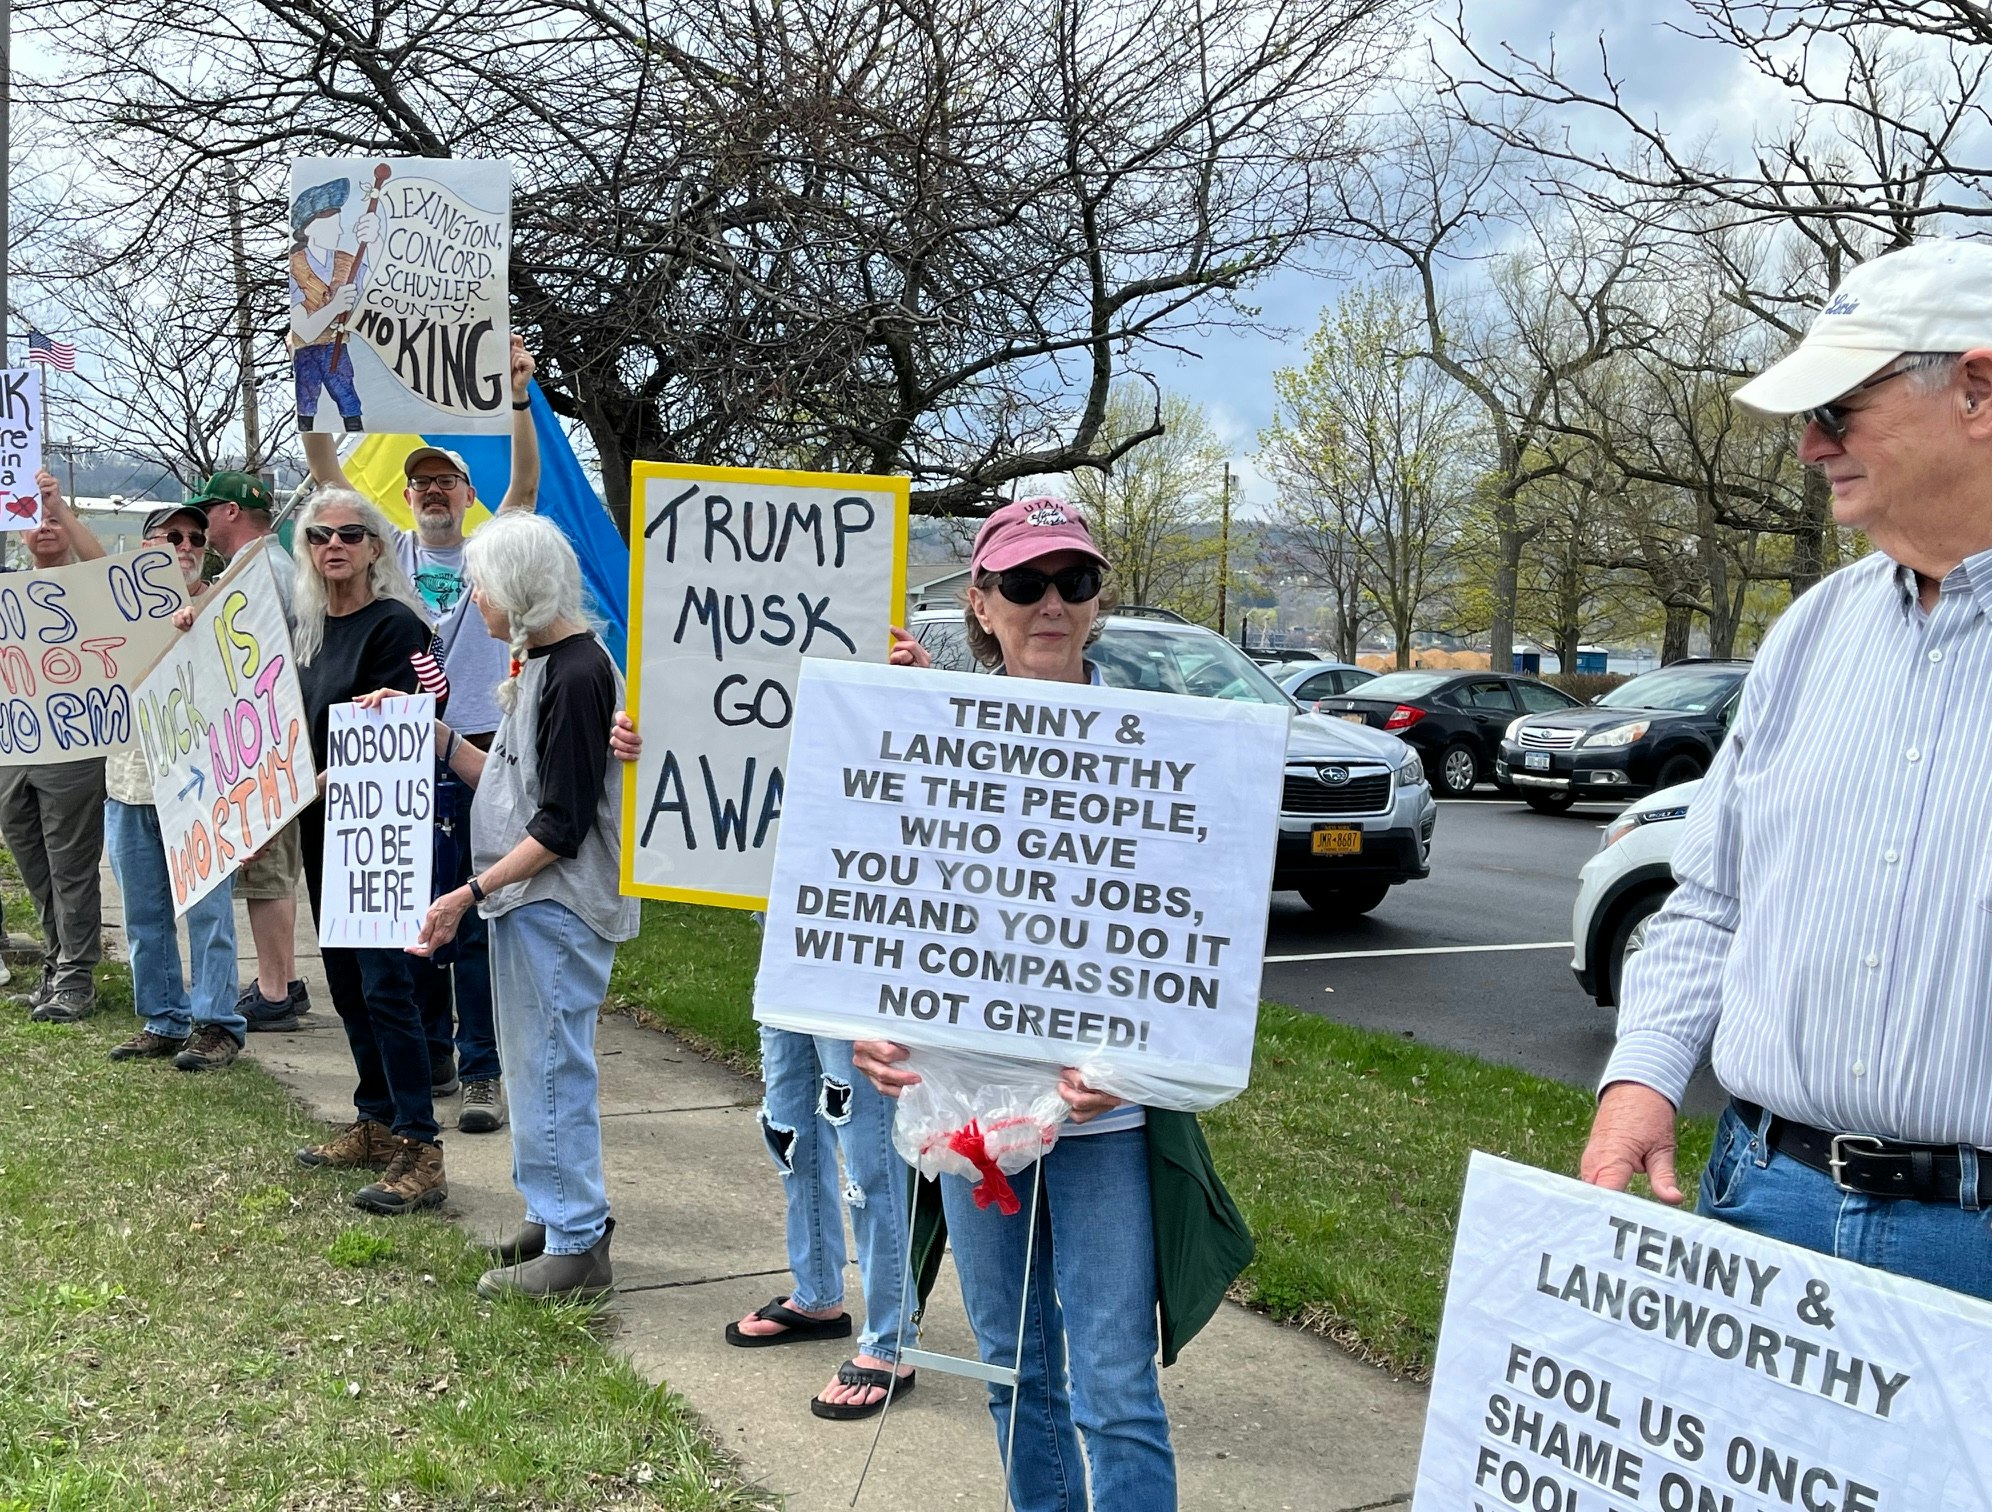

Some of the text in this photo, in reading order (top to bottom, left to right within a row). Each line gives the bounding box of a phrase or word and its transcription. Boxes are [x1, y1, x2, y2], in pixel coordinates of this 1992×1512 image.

[384, 187, 502, 250] LEXINGTON,
[375, 264, 490, 301] SCHUYLER
[388, 228, 495, 280] CONCORD,
[367, 289, 475, 324] COUNTY:
[355, 309, 503, 411] NO KING
[1, 470, 16, 486] a
[2, 451, 21, 468] in
[645, 484, 875, 569] TRUMP
[1023, 500, 1064, 513] UTAH
[109, 551, 182, 622] IS
[214, 589, 260, 697] IS
[674, 585, 857, 661] MUSK
[209, 654, 284, 795] NOT
[714, 674, 792, 729] GO
[950, 697, 1146, 745] TENNY &
[330, 721, 430, 767] NOBODY
[880, 731, 1196, 791] LANGWORTHY
[170, 719, 299, 905] WORTHY
[328, 778, 430, 821] PAID US
[640, 750, 784, 853] AWA
[843, 768, 1208, 843] WE THE PEOPLE,
[337, 824, 413, 866] TO BE
[901, 815, 1137, 869] WHO GAVE
[349, 869, 415, 922] HERE
[831, 848, 1204, 926] YOU YOUR JOBS,
[797, 885, 1230, 967] DEMAND YOU DO IT
[795, 927, 1219, 1009] WITH COMPASSION
[878, 984, 1150, 1051] NOT GREED!
[1609, 1215, 1836, 1331] TENNY &
[1537, 1252, 1911, 1418] LANGWORTHY
[1505, 1342, 1622, 1429] FOOL
[1639, 1397, 1706, 1462] US
[1485, 1393, 1644, 1500] SHAME
